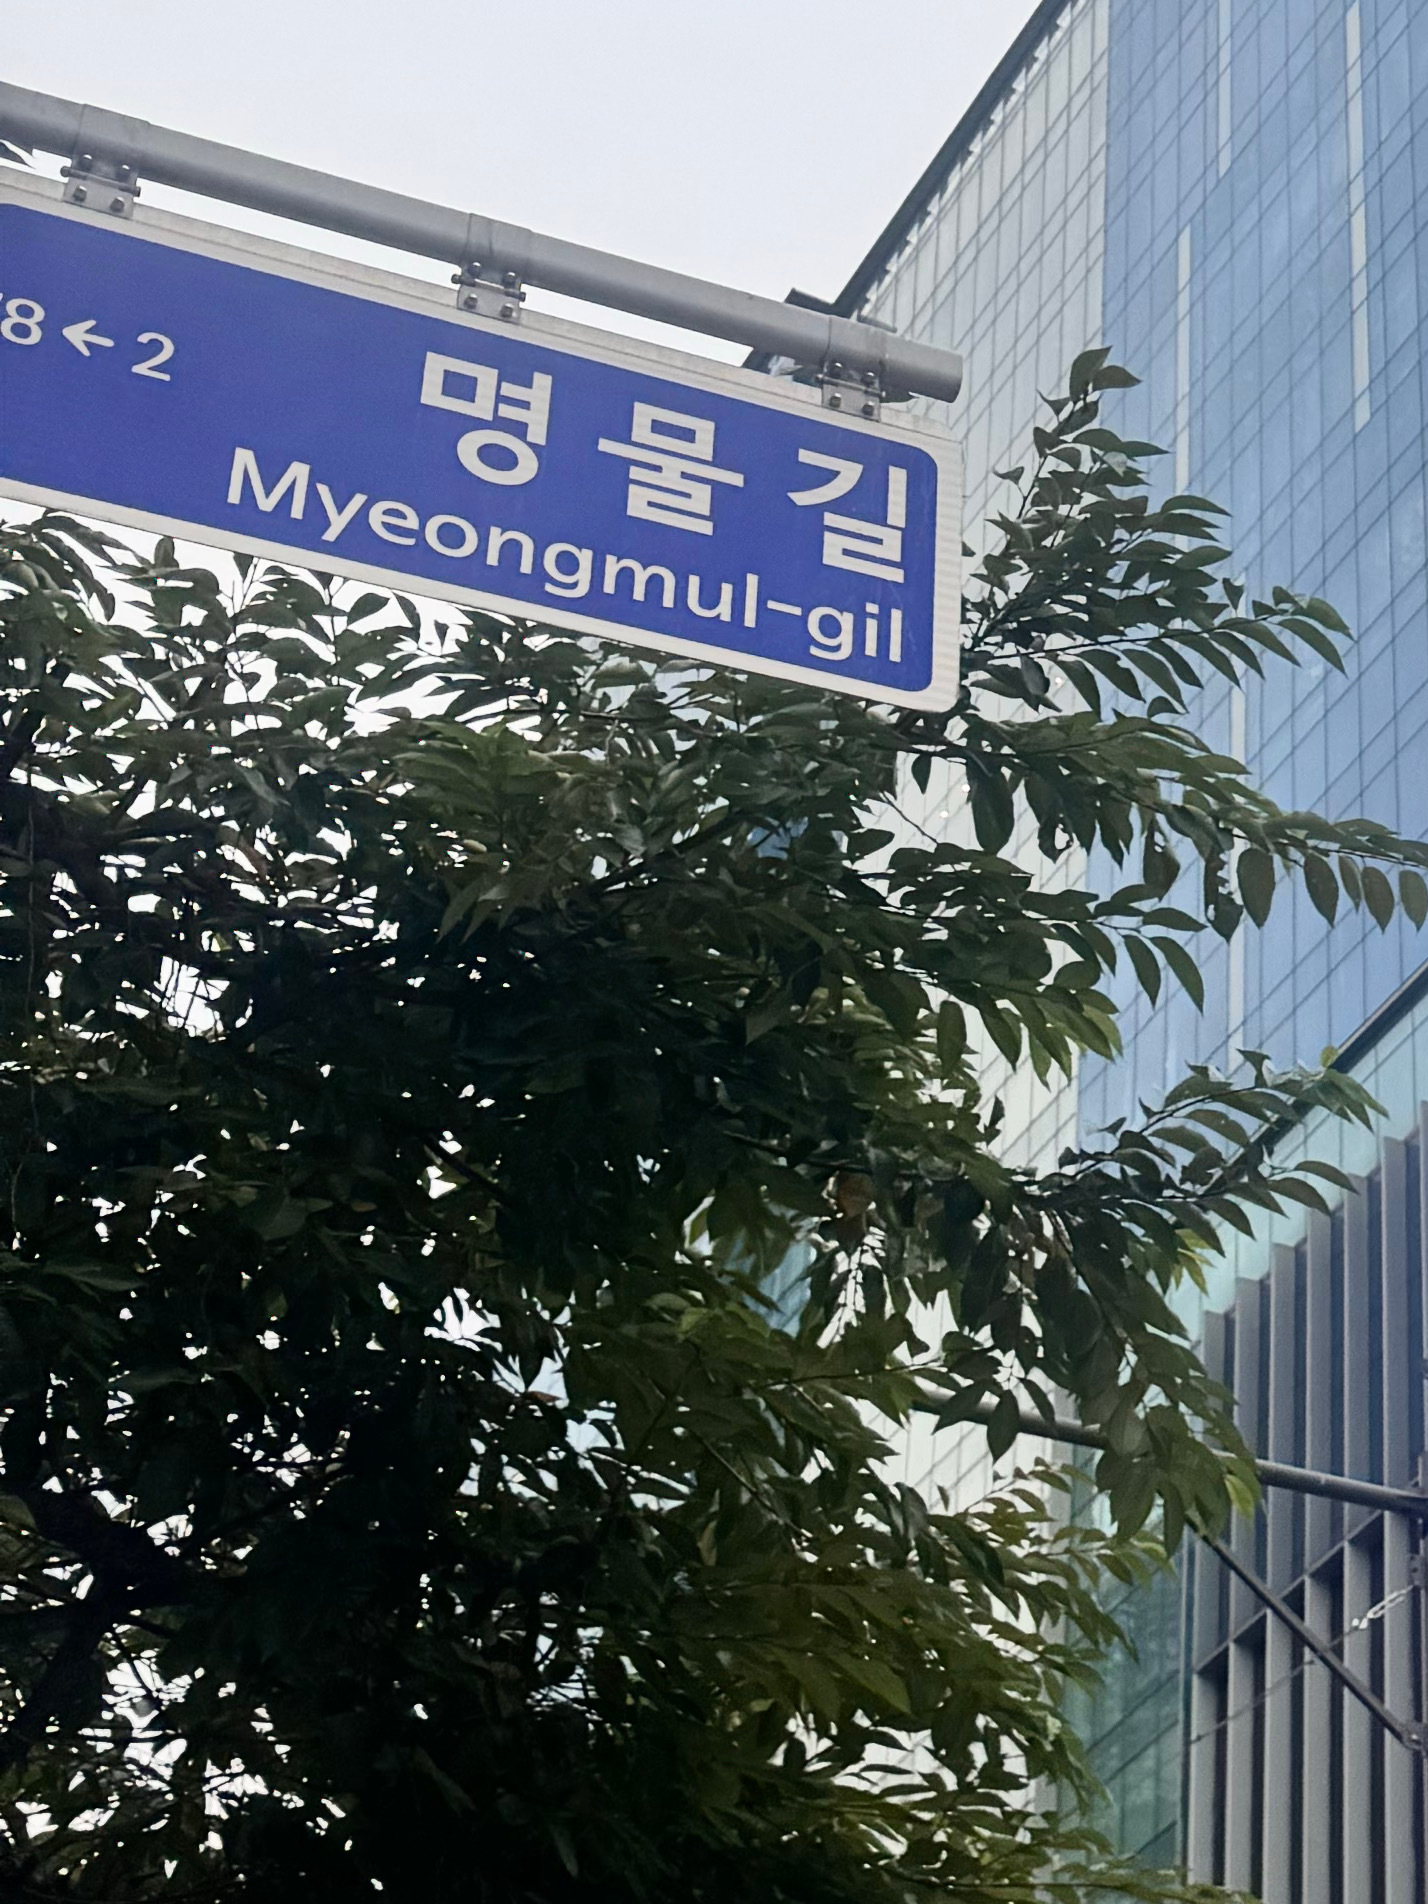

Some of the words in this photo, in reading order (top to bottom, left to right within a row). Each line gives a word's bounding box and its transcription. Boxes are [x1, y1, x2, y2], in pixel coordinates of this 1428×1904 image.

[0, 292, 46, 346] 8
[130, 331, 175, 382] 2
[225, 446, 904, 664] Myeongmul-gil
[419, 350, 906, 584] 명물길
